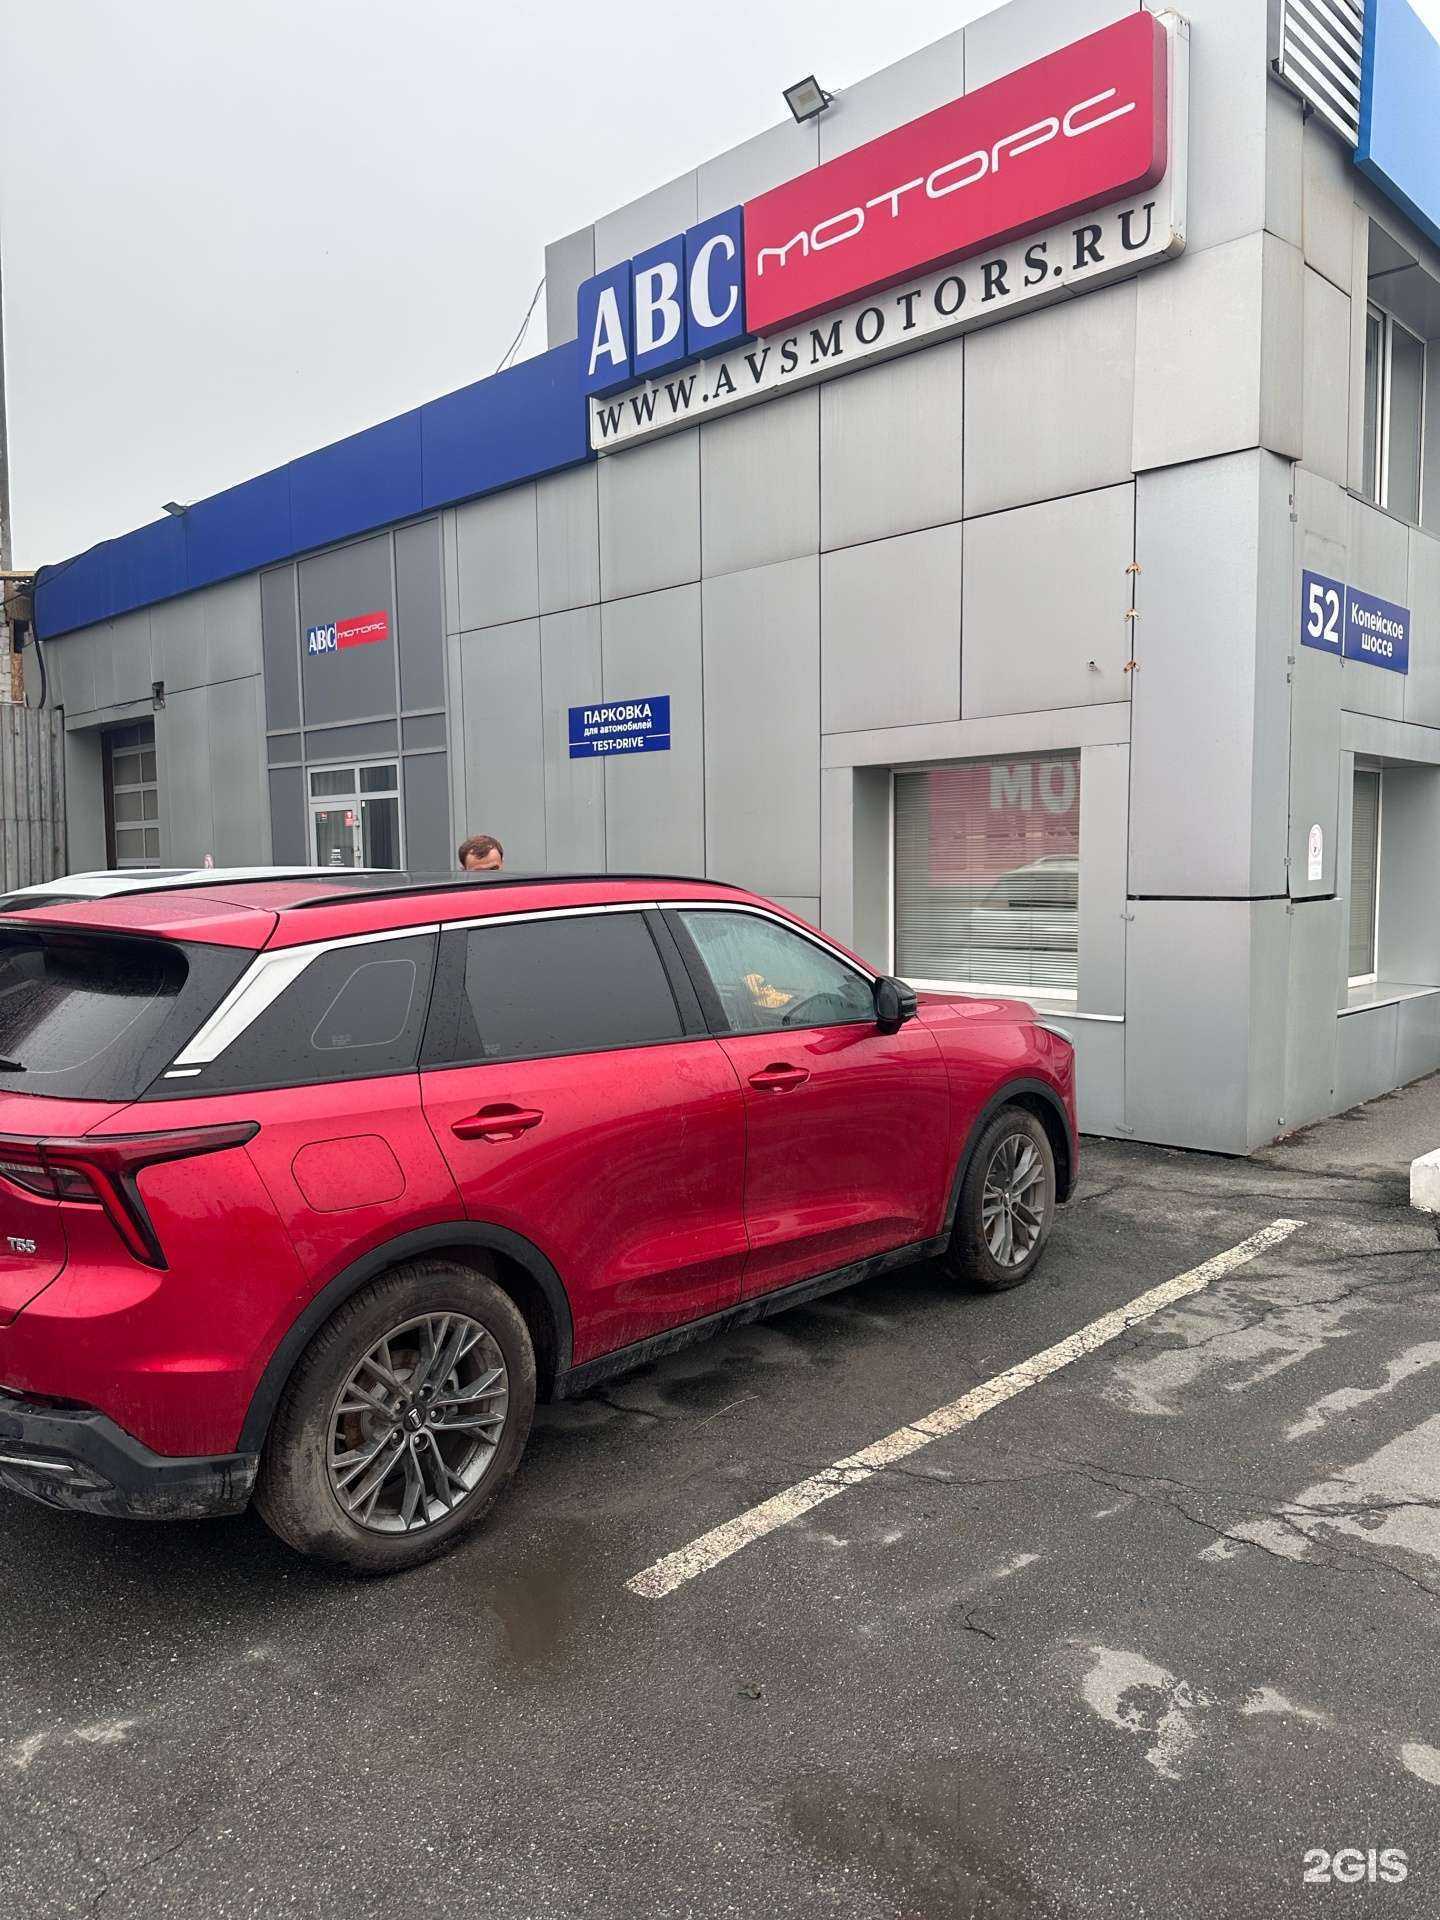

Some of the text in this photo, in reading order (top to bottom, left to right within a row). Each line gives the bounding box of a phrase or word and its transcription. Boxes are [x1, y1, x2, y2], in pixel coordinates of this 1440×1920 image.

[596, 201, 1156, 440] WWW.AVSMOTORS.RU
[1307, 582, 1340, 644] 52
[1351, 602, 1404, 640] Копейское
[1361, 632, 1393, 658] шоссе
[584, 703, 653, 725] ПАРКОВКА
[584, 718, 653, 737] для автомобилей
[592, 736, 644, 752] TEST-DRIVE
[7, 1236, 37, 1254] T55
